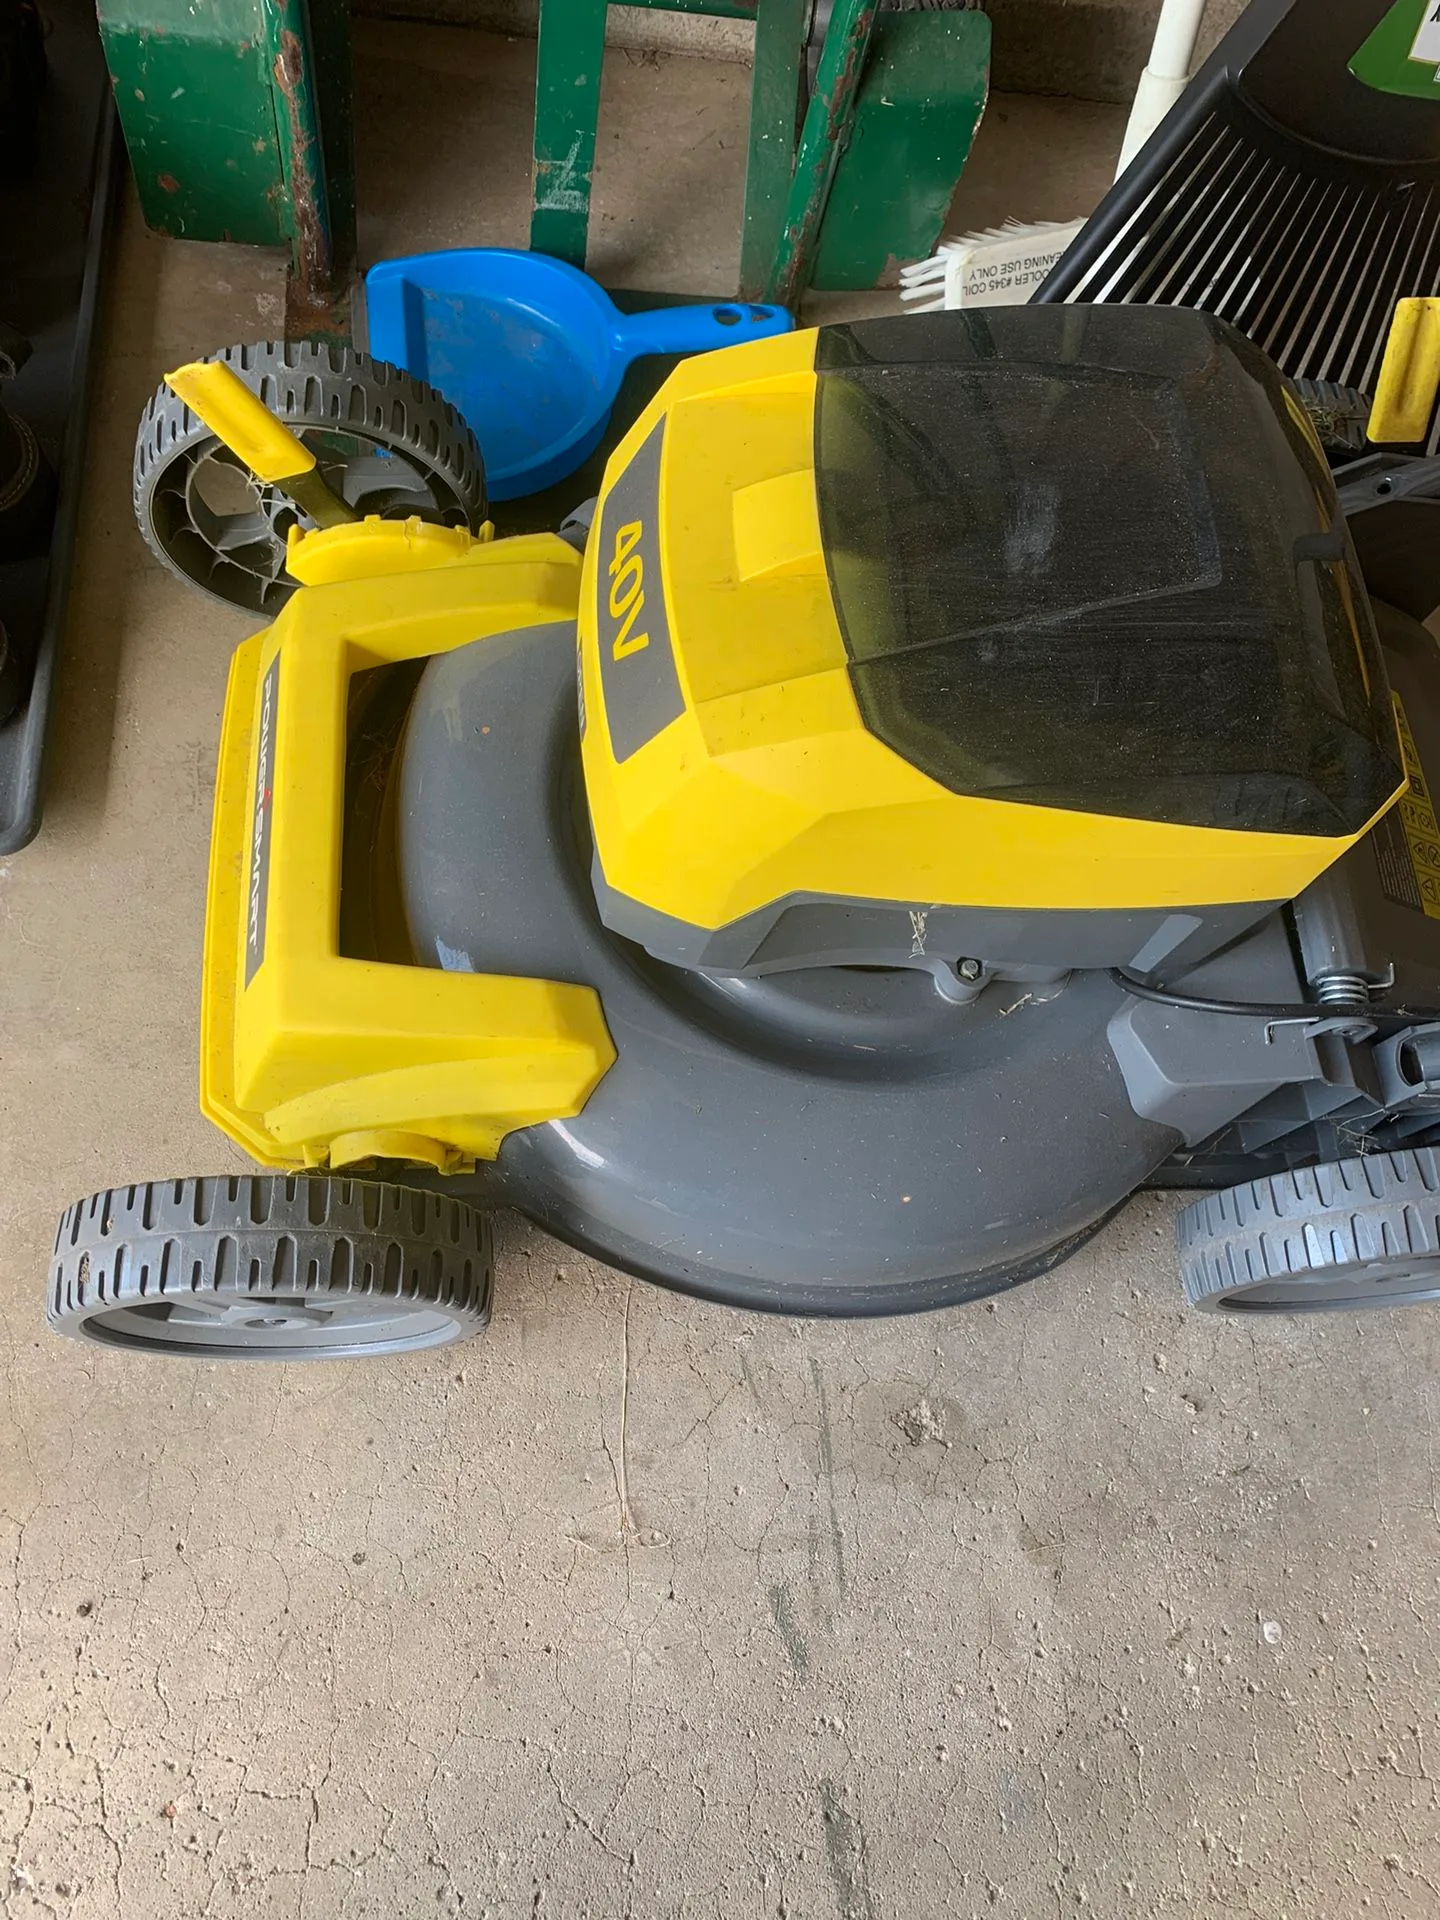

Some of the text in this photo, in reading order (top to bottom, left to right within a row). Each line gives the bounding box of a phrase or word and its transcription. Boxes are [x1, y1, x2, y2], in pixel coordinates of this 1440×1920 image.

[969, 251, 1063, 281] EANING USE ONLY
[963, 268, 1051, 296] OOLER #345 COIL
[608, 519, 650, 662] 40V
